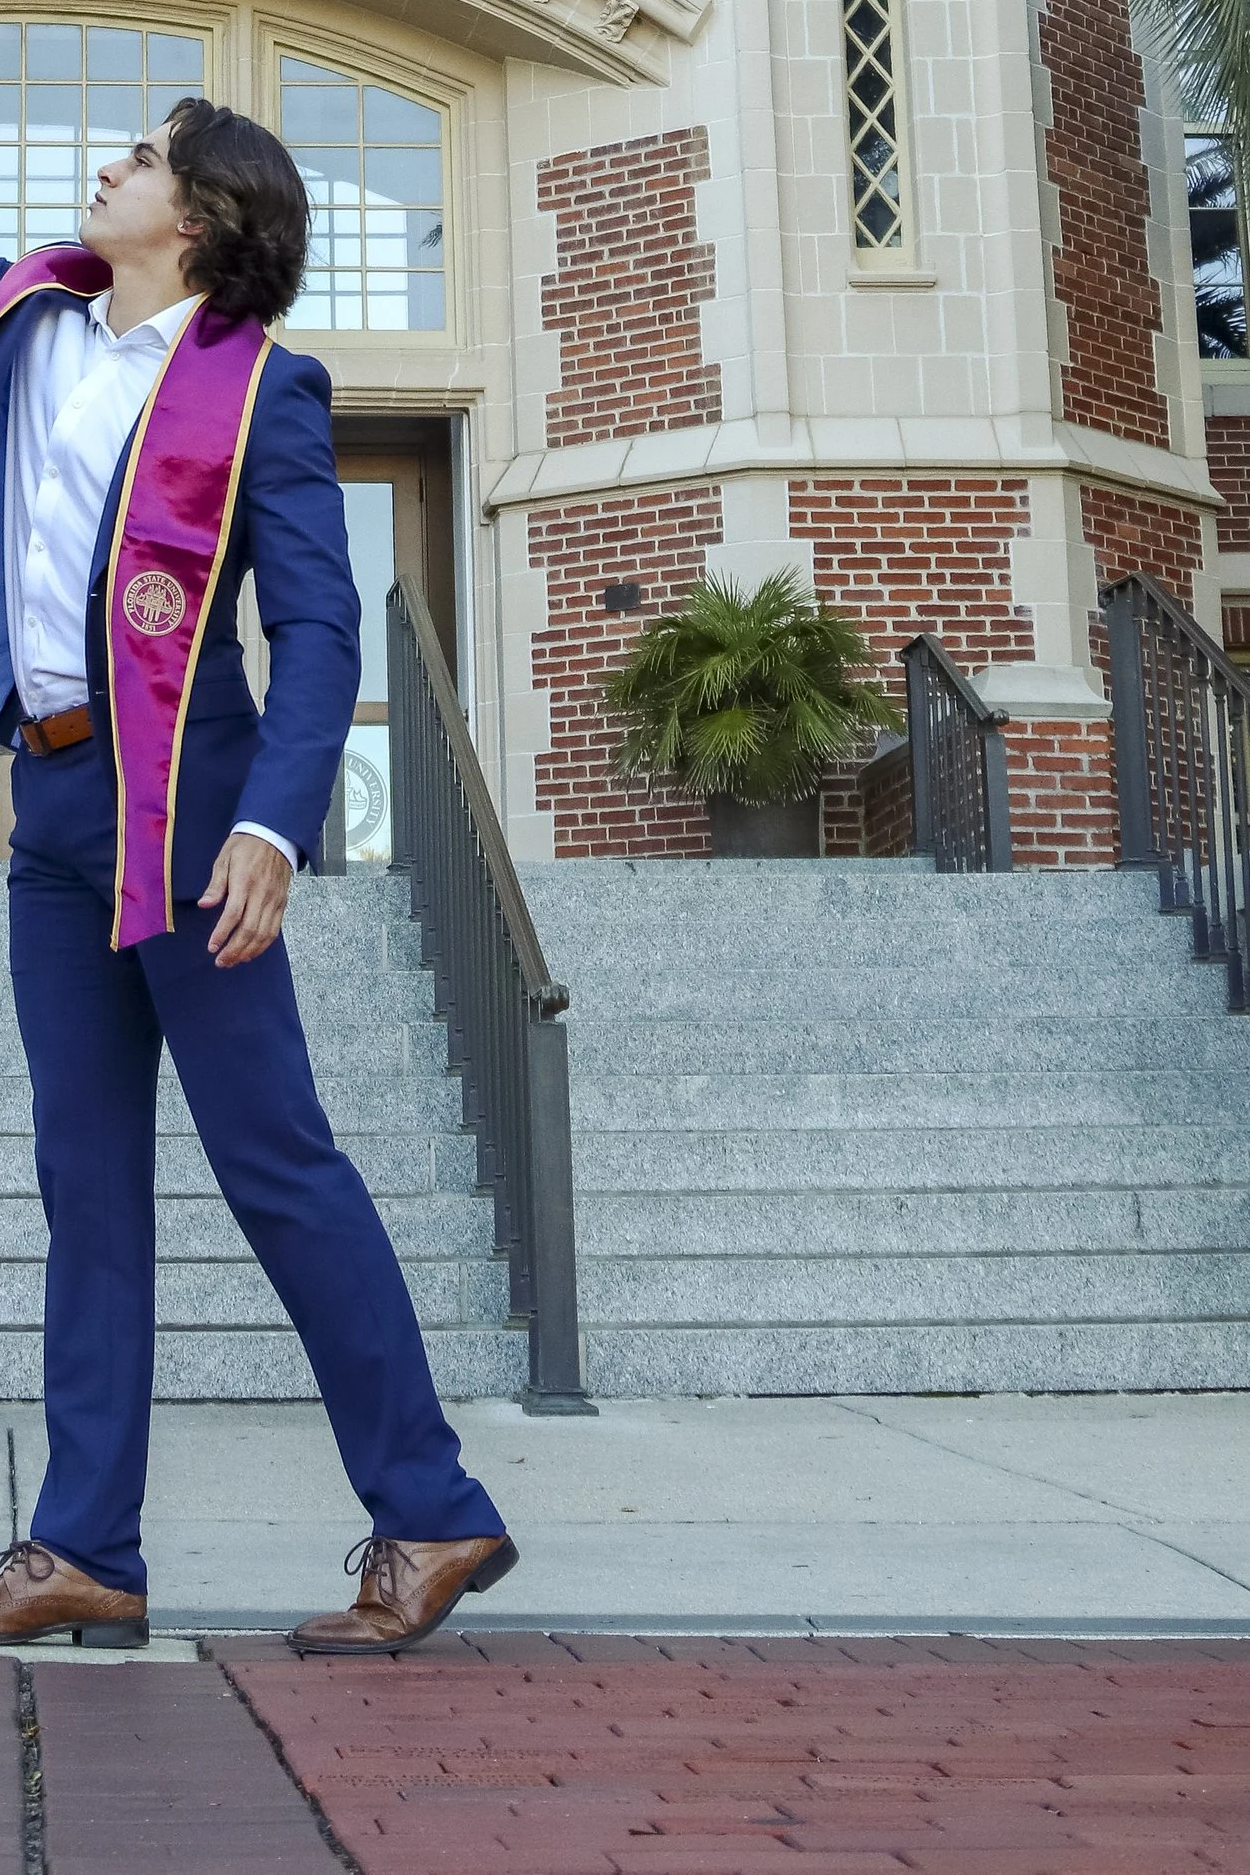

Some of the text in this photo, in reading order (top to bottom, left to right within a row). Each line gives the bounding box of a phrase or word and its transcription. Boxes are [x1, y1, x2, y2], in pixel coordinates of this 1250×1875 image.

[127, 575, 182, 627] FLORIDA STATE UNIVERSITY
[348, 757, 382, 827] UNIVERSITY
